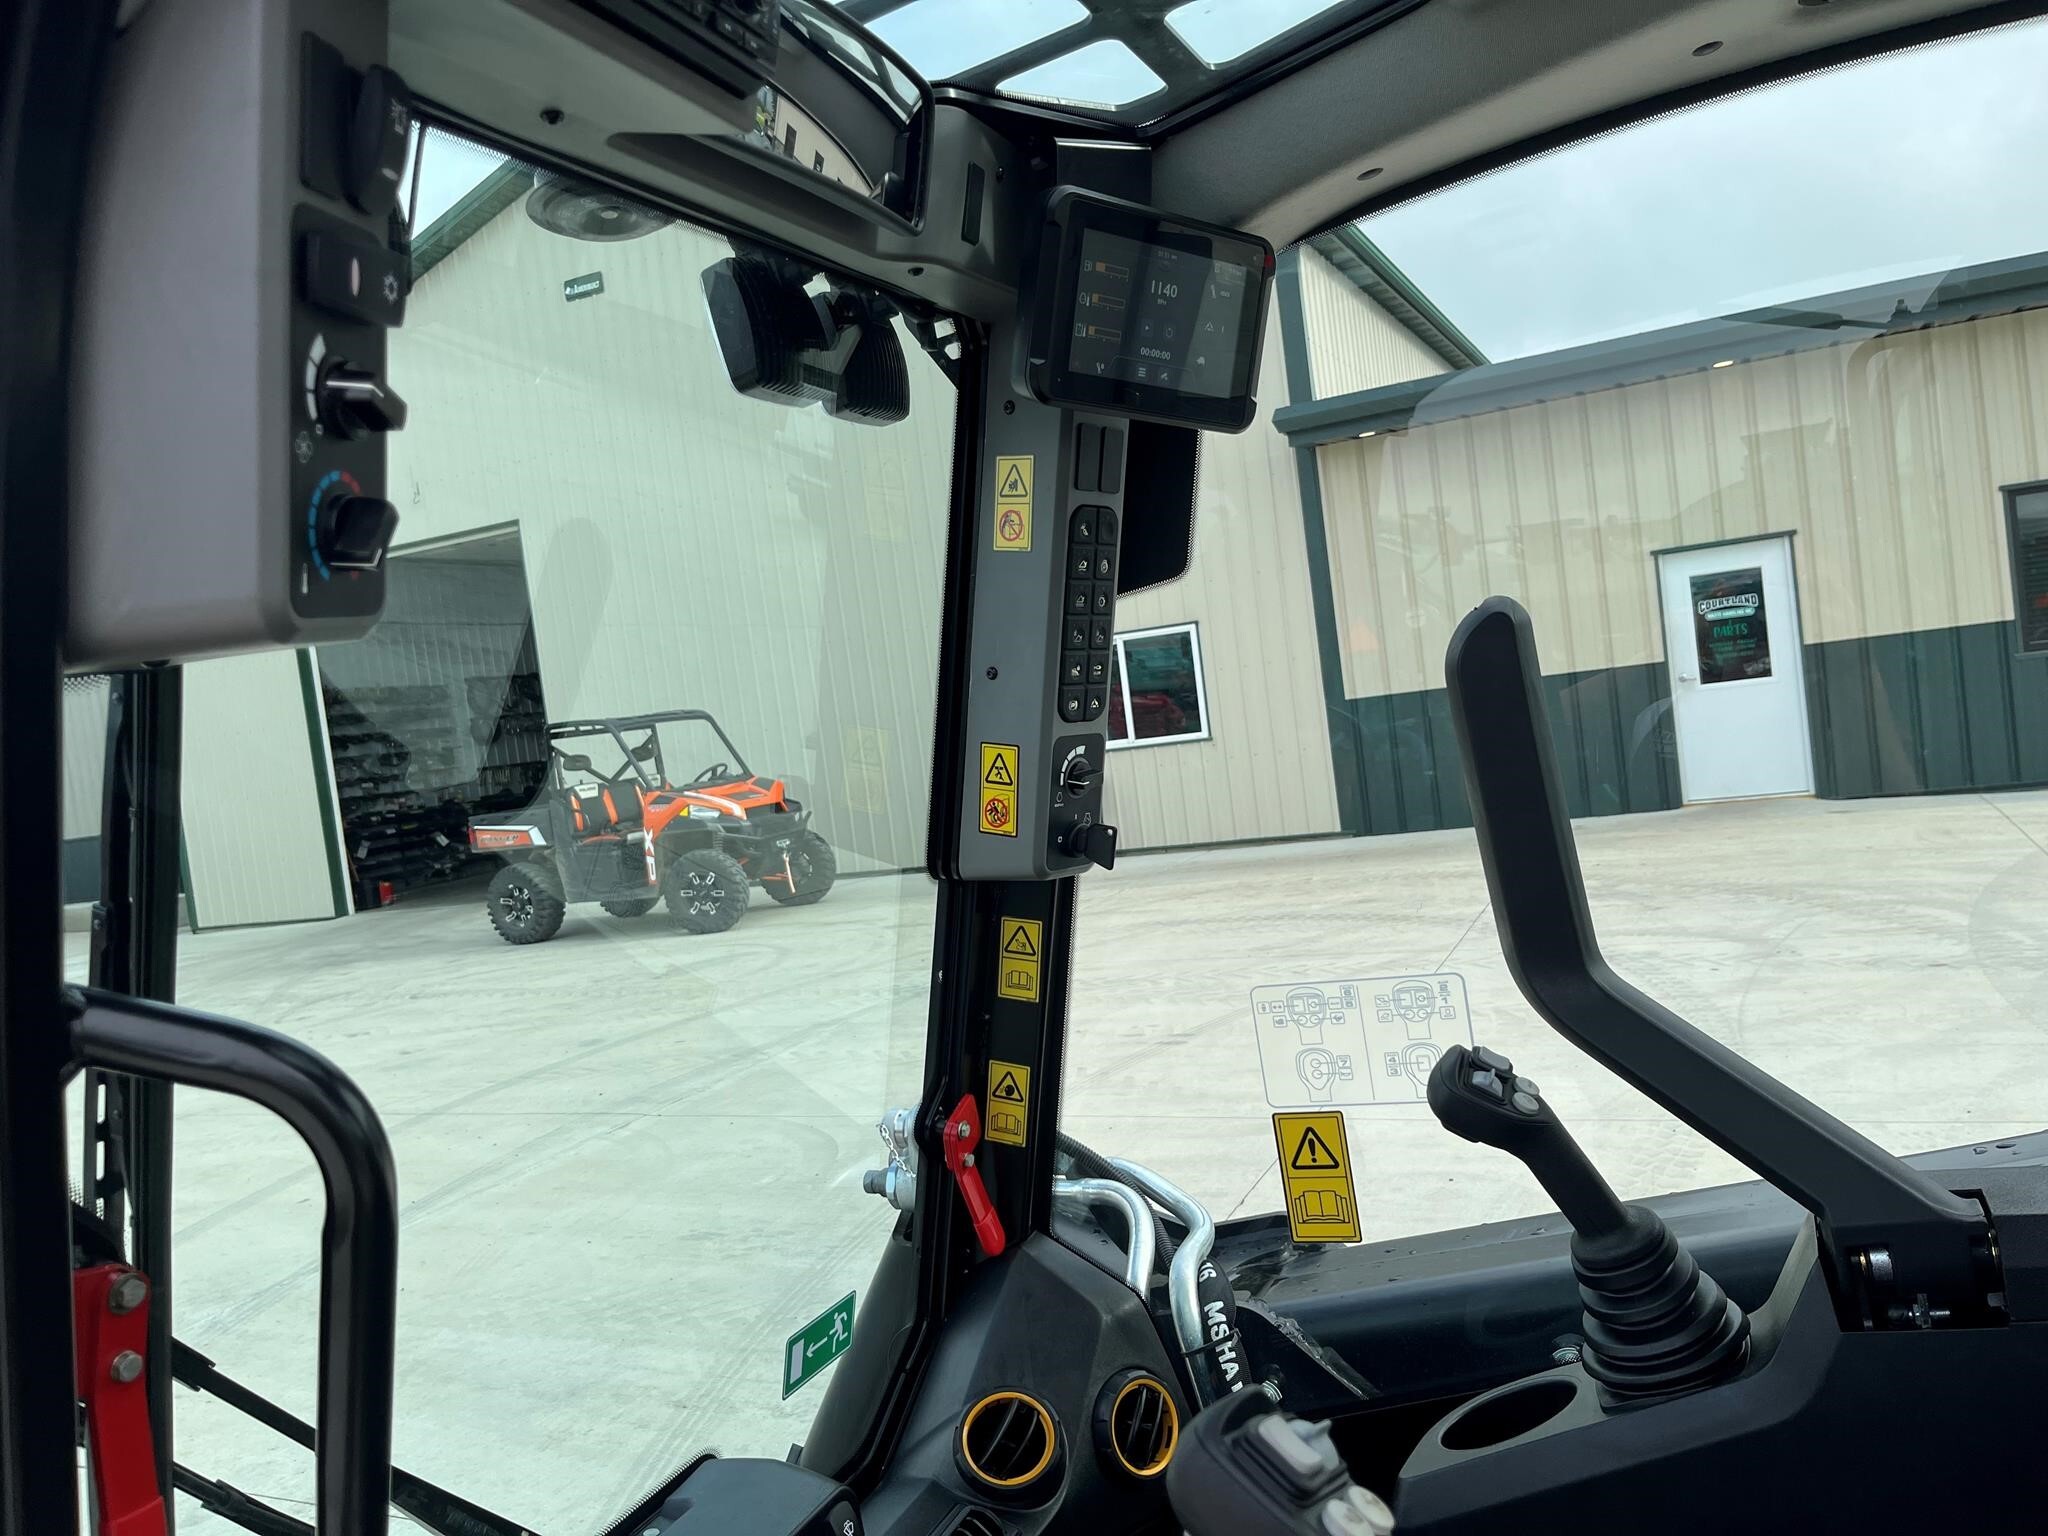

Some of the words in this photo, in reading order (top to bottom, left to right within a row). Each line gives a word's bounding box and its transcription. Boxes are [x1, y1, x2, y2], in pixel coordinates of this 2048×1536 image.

[1151, 279, 1178, 299] 1140
[1140, 347, 1171, 361] 00:00:00
[1698, 594, 1758, 614] COURTLAND
[1714, 623, 1748, 638] PARTS
[1204, 1301, 1239, 1381] MSHA
